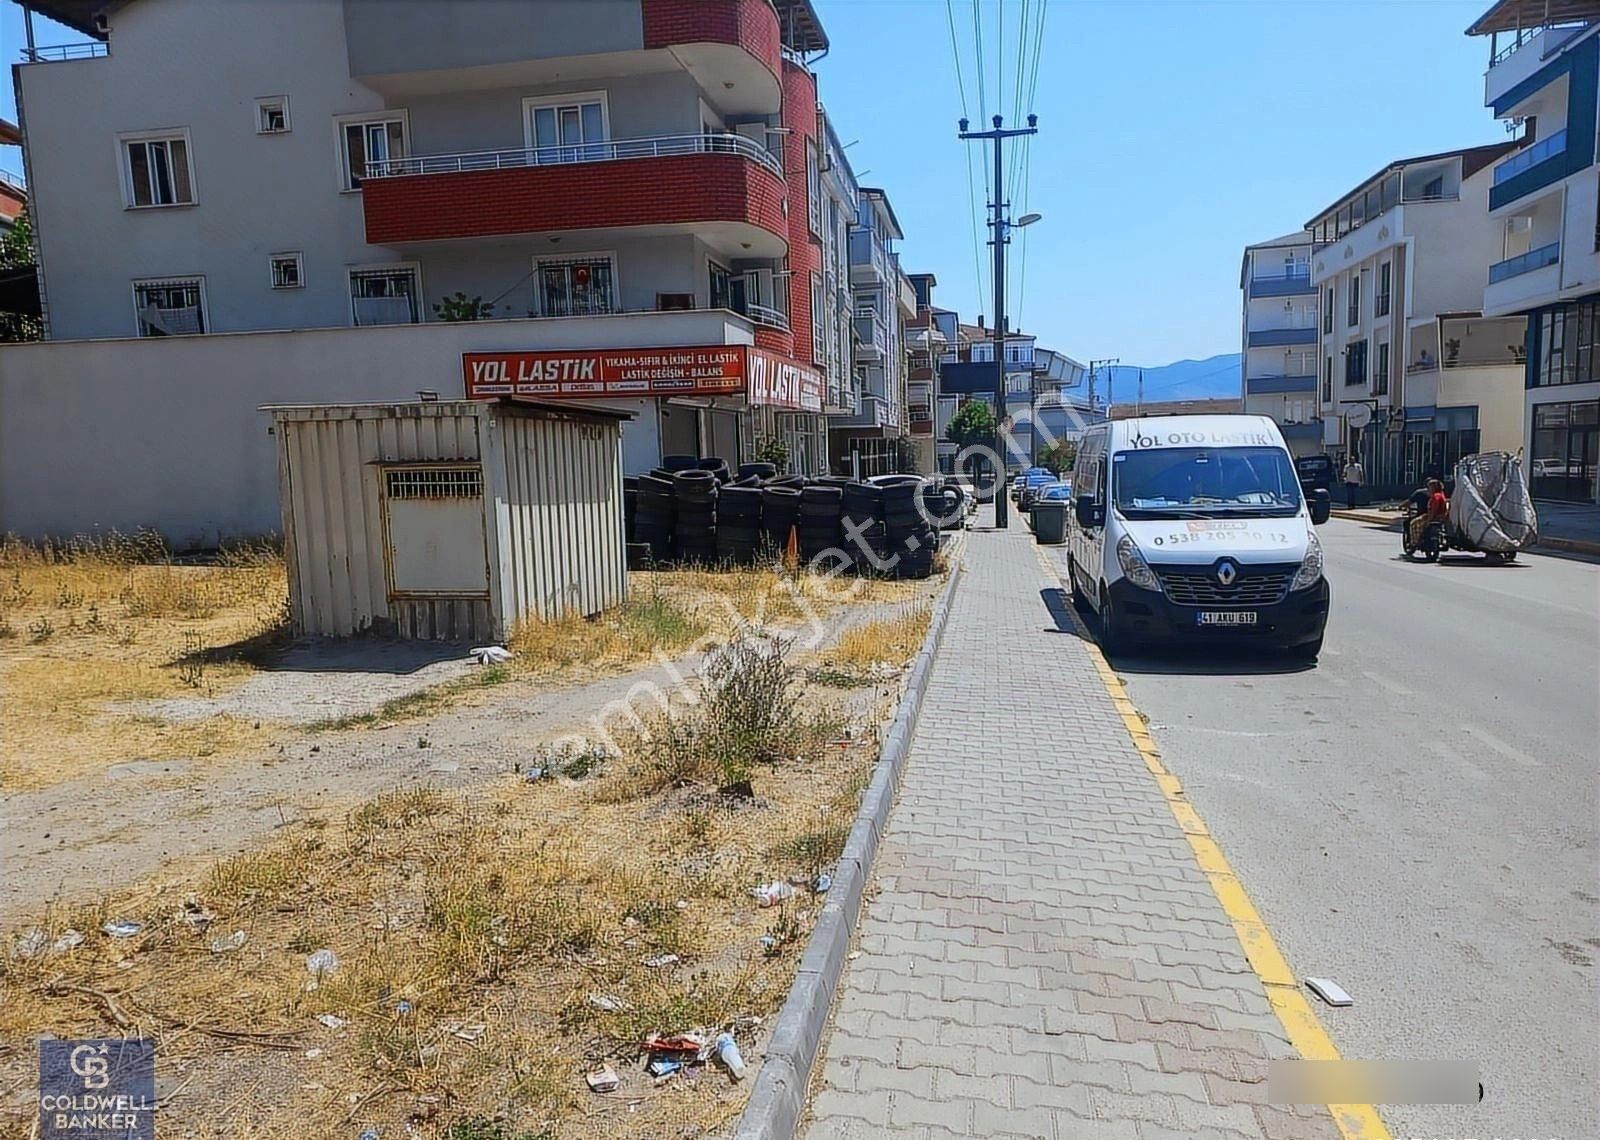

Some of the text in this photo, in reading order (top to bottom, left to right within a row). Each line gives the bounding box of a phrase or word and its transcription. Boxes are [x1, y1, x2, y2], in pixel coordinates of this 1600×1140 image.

[698, 354, 708, 364] EL
[472, 361, 511, 382] YOL
[691, 366, 724, 377] BALANS
[749, 355, 768, 397] YOL
[1130, 435, 1163, 448] YOL
[1168, 432, 1206, 445] OTO
[1169, 532, 1200, 544] 538
[1202, 612, 1212, 623] 41
